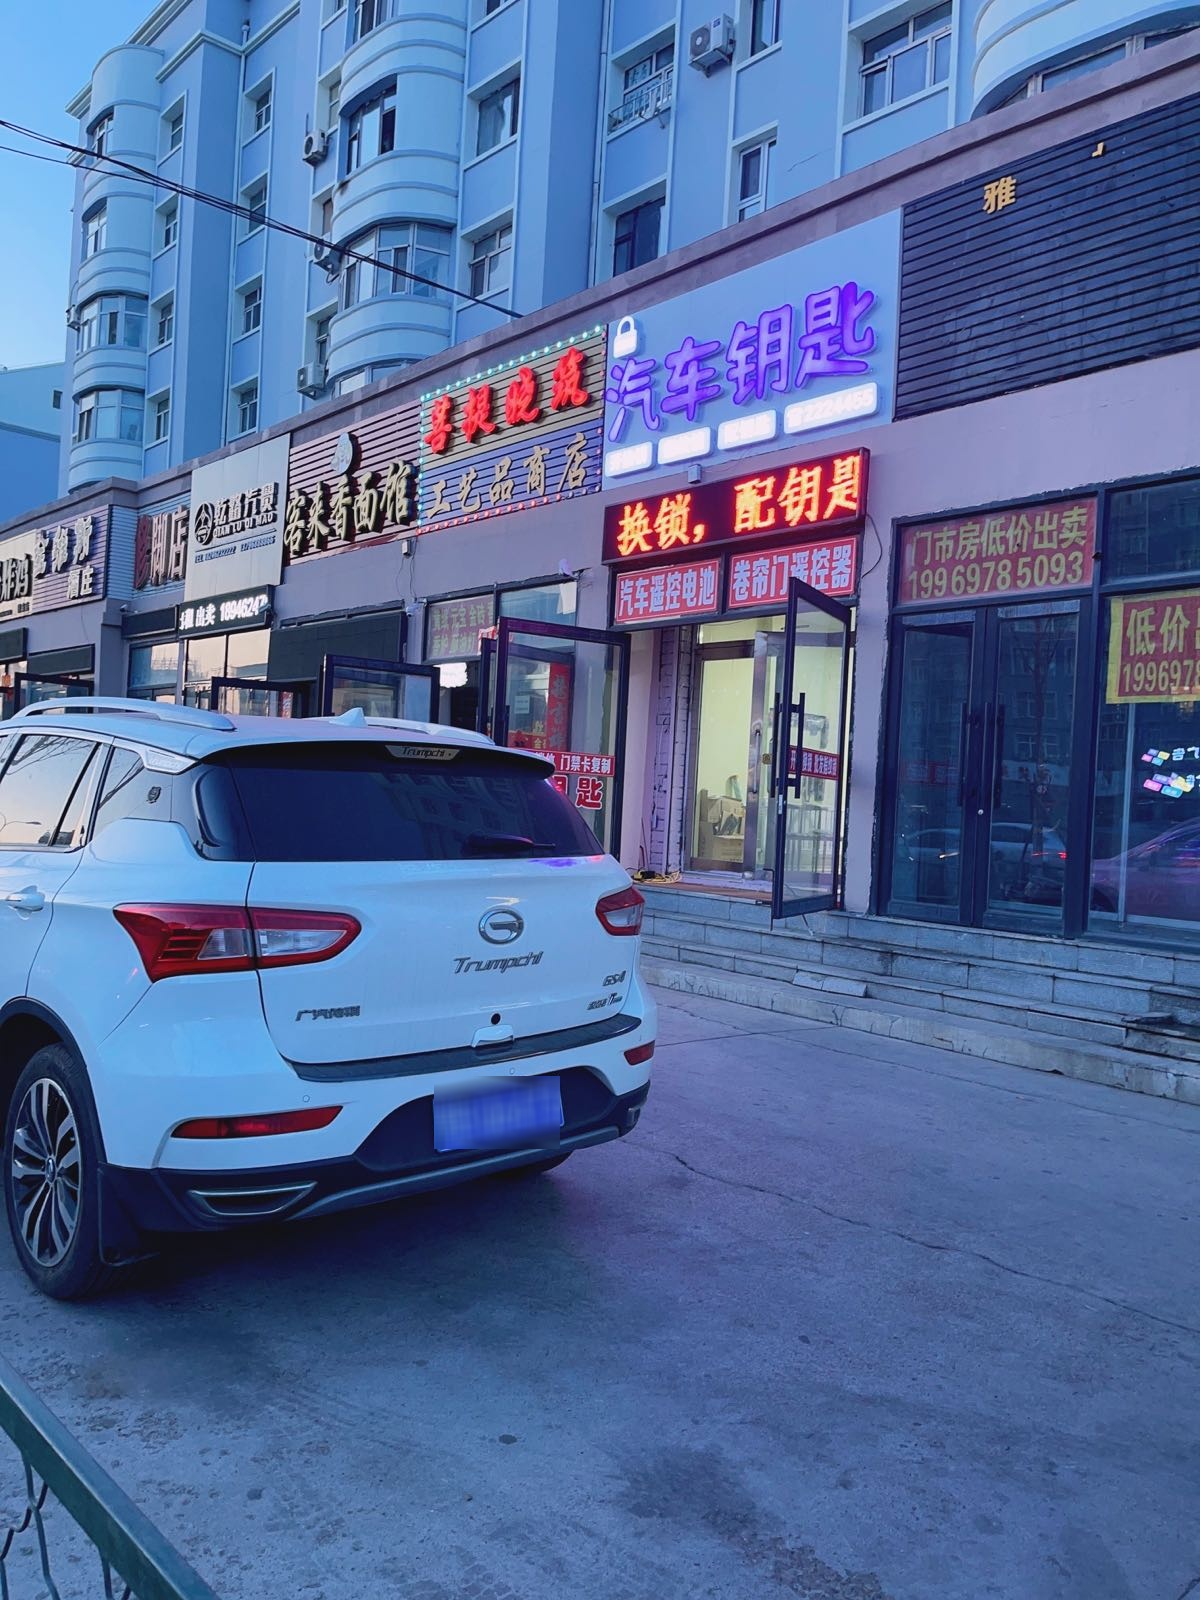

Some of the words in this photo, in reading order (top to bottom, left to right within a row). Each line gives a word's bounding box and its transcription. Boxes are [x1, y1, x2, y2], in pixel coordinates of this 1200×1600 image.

[982, 175, 1017, 214] 雅
[605, 281, 875, 442] 汽车钥匙
[426, 432, 589, 519] 工艺品商店
[284, 460, 412, 556] 客来香面馆
[911, 505, 1088, 567] 门市房低价出卖
[619, 566, 715, 616] 汽车遥控电池
[733, 544, 852, 601] 卷帘门遥控器
[402, 746, 446, 758] Trumpchi
[560, 754, 612, 774] 门禁卡复制
[453, 951, 544, 974] Trumpchi
